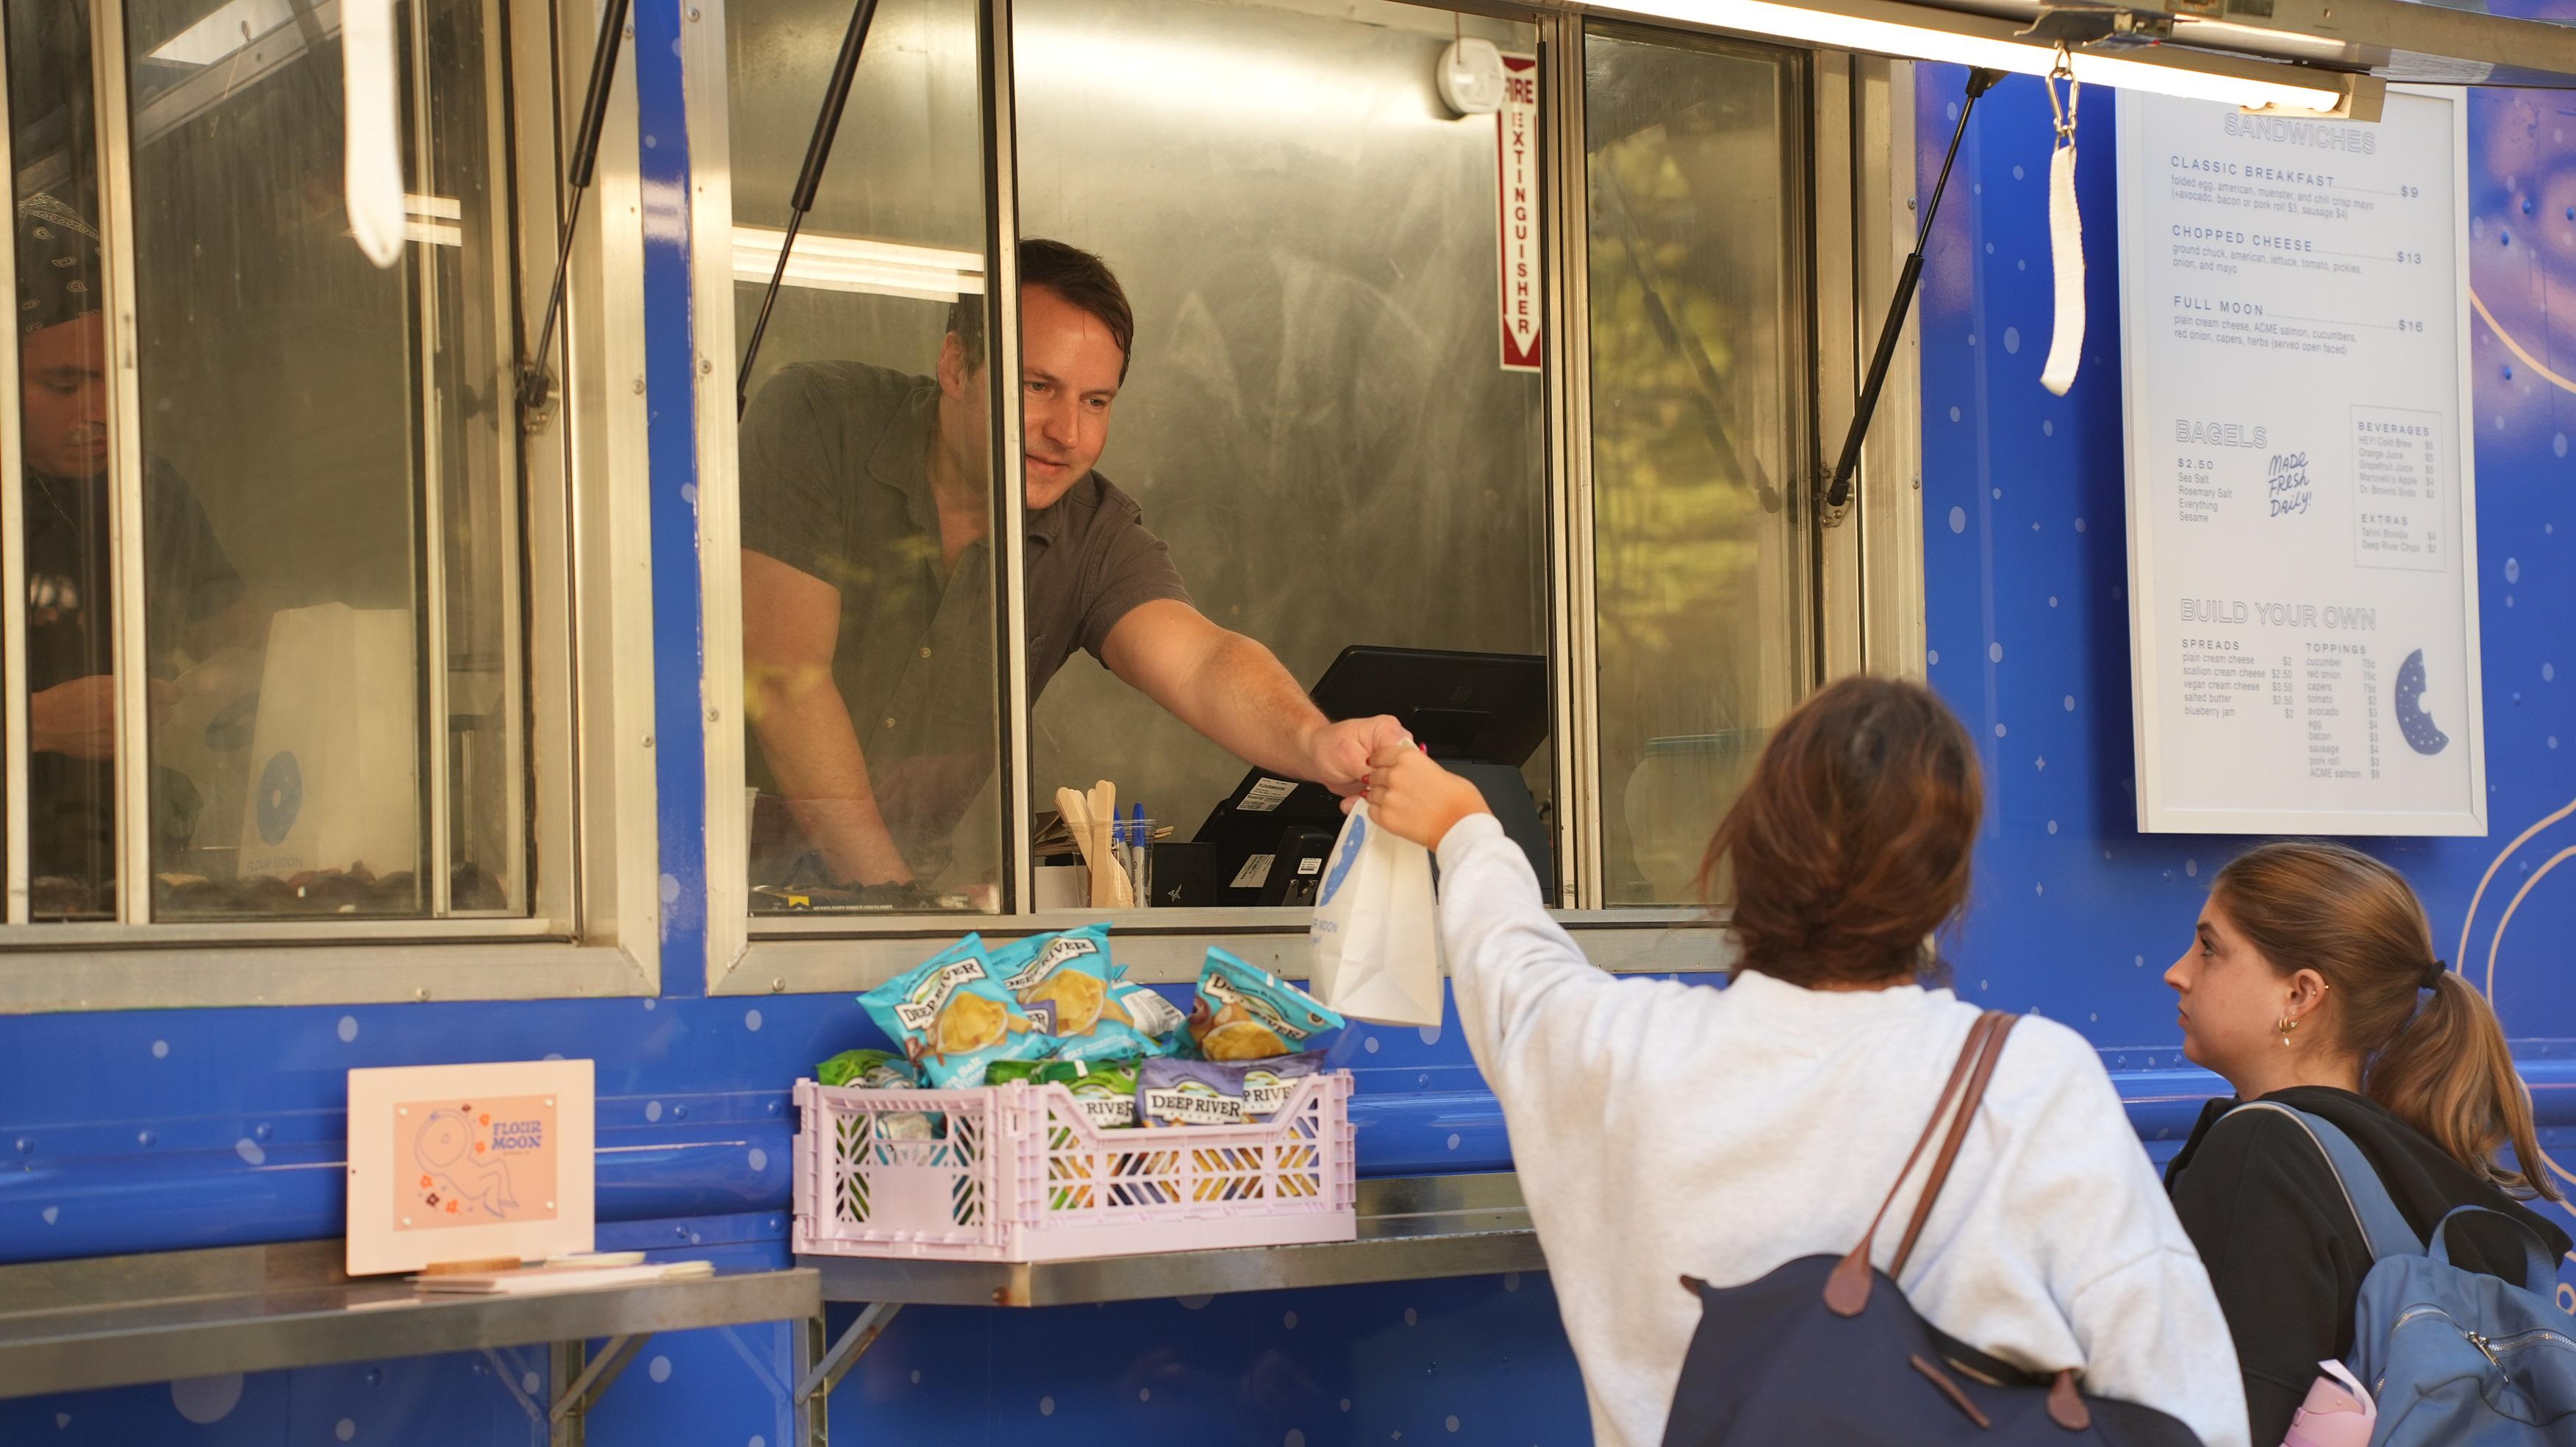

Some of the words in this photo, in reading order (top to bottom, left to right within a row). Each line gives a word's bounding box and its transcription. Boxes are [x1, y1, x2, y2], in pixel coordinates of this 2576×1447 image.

[2224, 112, 2376, 154] SANDWICHES
[2171, 155, 2237, 175] CLASSIC
[2245, 165, 2334, 187] BREAKFAST
[2401, 185, 2419, 199] $9
[2172, 174, 2196, 187] folded
[2298, 192, 2311, 202] and
[2217, 193, 2241, 205] bacon
[2254, 199, 2271, 210] pork
[2302, 205, 2334, 219] sausage
[1511, 112, 1529, 334] EXTINGUISHER
[2172, 224, 2244, 244] CHOPPED
[2253, 235, 2312, 252] CHEESE
[2397, 250, 2422, 265] $13
[2172, 243, 2200, 255] ground
[2203, 246, 2228, 260] chuck,
[2230, 251, 2268, 264] american,
[2173, 258, 2197, 270] onion,
[2200, 260, 2214, 271] and
[2217, 264, 2238, 275] mayo
[2174, 296, 2212, 311] FULL
[2220, 300, 2263, 316] MOON
[2398, 318, 2423, 332] $16
[2174, 315, 2192, 327] plain
[2195, 317, 2219, 328] cream
[2222, 319, 2252, 332] cheese,
[2254, 322, 2278, 335] ACME
[2174, 329, 2187, 339] red
[2190, 329, 2214, 343] onion,
[2217, 333, 2244, 346] capers,
[2247, 335, 2269, 347] herbs
[2302, 342, 2321, 353] open
[2176, 419, 2268, 449] BAGELS
[2358, 421, 2429, 436] BEVERAGES
[2178, 457, 2214, 470] $2.50
[2178, 472, 2192, 482] Sea
[2194, 474, 2209, 484] Salt
[2179, 485, 2215, 499] Rosemary
[2217, 488, 2233, 499] Salt
[2179, 498, 2218, 512] Everything
[2179, 511, 2208, 523] Sesame
[2361, 513, 2408, 526] EXTRAS
[2181, 599, 2248, 624] BUILD
[2255, 602, 2317, 627] YOUR
[2323, 606, 2376, 631] OWN
[2182, 639, 2240, 650] SPREADS
[2305, 642, 2366, 654] TOPPINGS
[2183, 653, 2200, 664] plain
[2203, 654, 2226, 663] cream
[2228, 654, 2255, 665] cheese
[2183, 667, 2211, 676] scallion
[2214, 668, 2236, 677] cream
[2239, 668, 2266, 678] cheese
[2183, 681, 2205, 691] vegan
[2208, 682, 2231, 690] cream
[2233, 681, 2260, 691] cheese
[2307, 683, 2332, 692] capers
[2183, 693, 2207, 703] salted
[2209, 693, 2232, 703] butter
[2185, 706, 2219, 718] blueberry
[2222, 707, 2236, 718] jam
[2308, 731, 2332, 741] bacon
[2309, 745, 2340, 756] sausage
[2335, 769, 2361, 779] salmon
[903, 999, 937, 1022] DEEP
[1152, 1095, 1192, 1112] DEEP
[1195, 1099, 1241, 1117] RIVER
[493, 1120, 541, 1135] FLOUR
[491, 1135, 542, 1151] MOON
